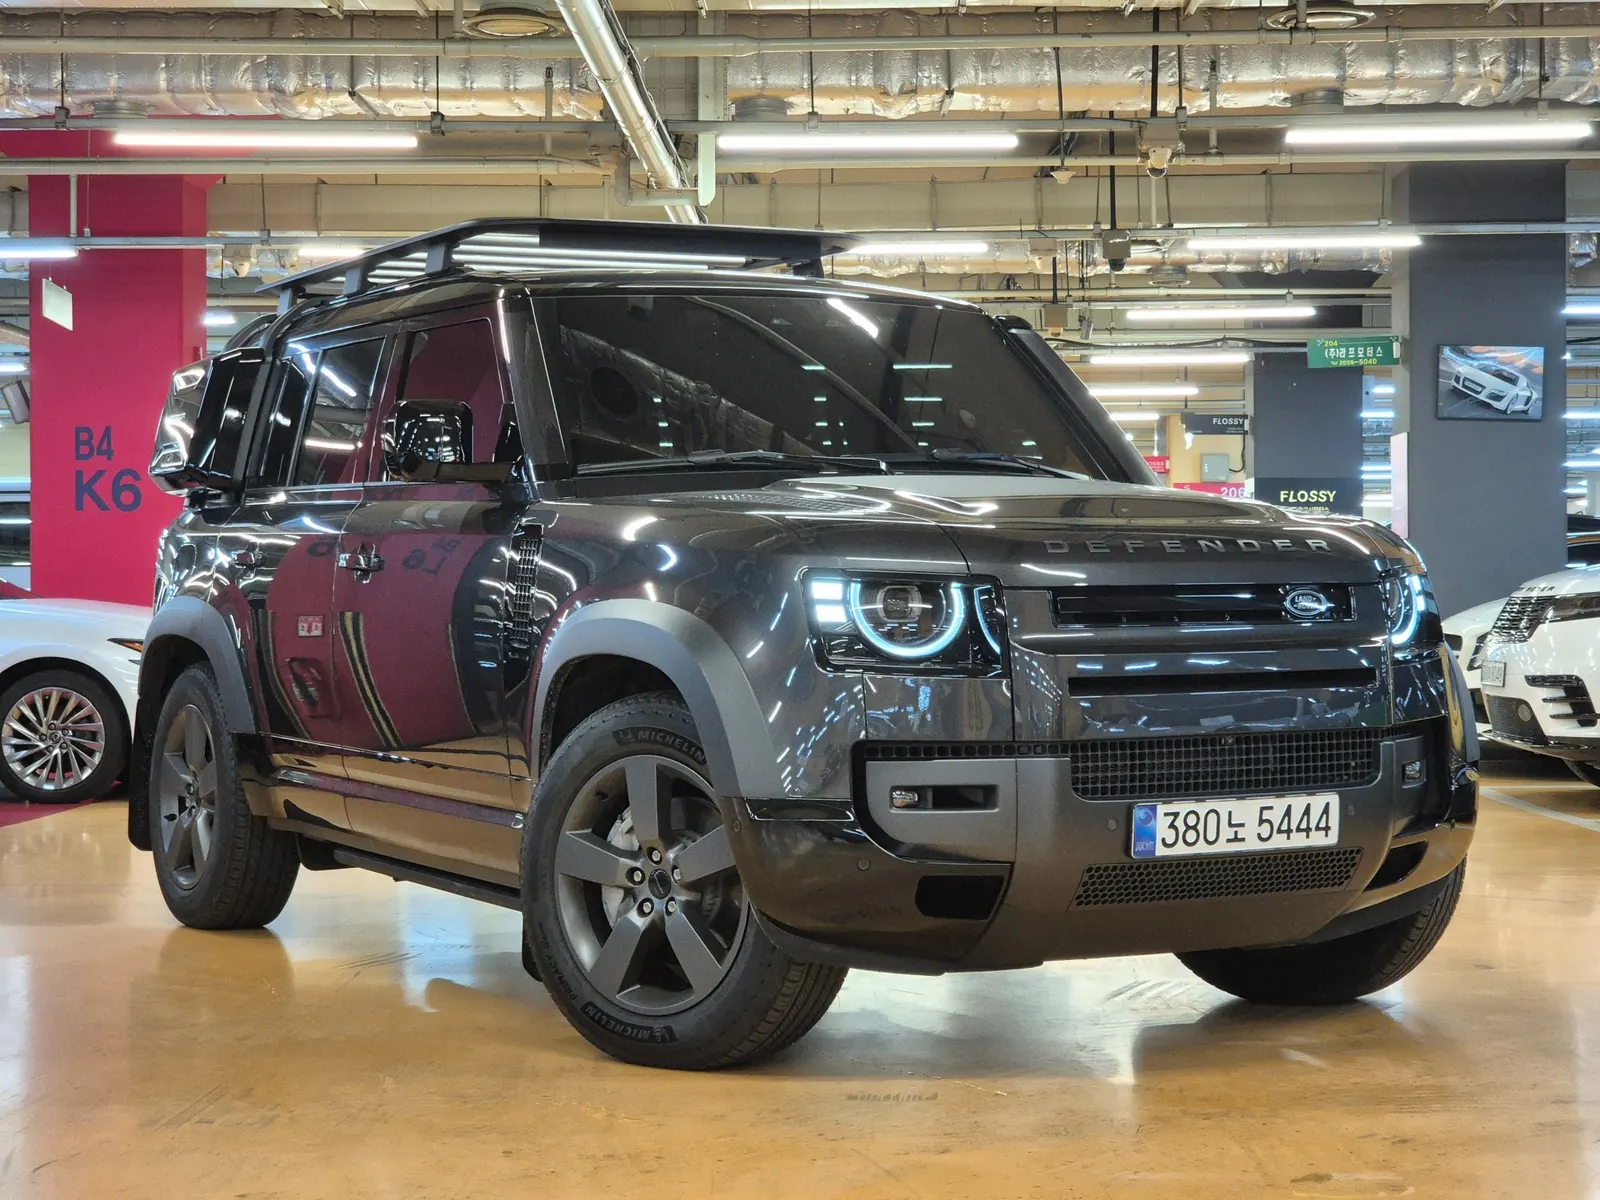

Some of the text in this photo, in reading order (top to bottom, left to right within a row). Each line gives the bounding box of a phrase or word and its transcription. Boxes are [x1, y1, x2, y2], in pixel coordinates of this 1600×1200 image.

[1212, 417, 1244, 425] FLOSSY
[75, 425, 115, 461] B4
[75, 468, 143, 512] K6
[1220, 486, 1245, 498] 206
[1280, 490, 1337, 503] FLOSSY
[1042, 538, 1333, 554] DEFENDER
[637, 730, 706, 761] MICHELIN
[1161, 801, 1332, 849] 380노 5444
[584, 1004, 651, 1040] MICHELIN
